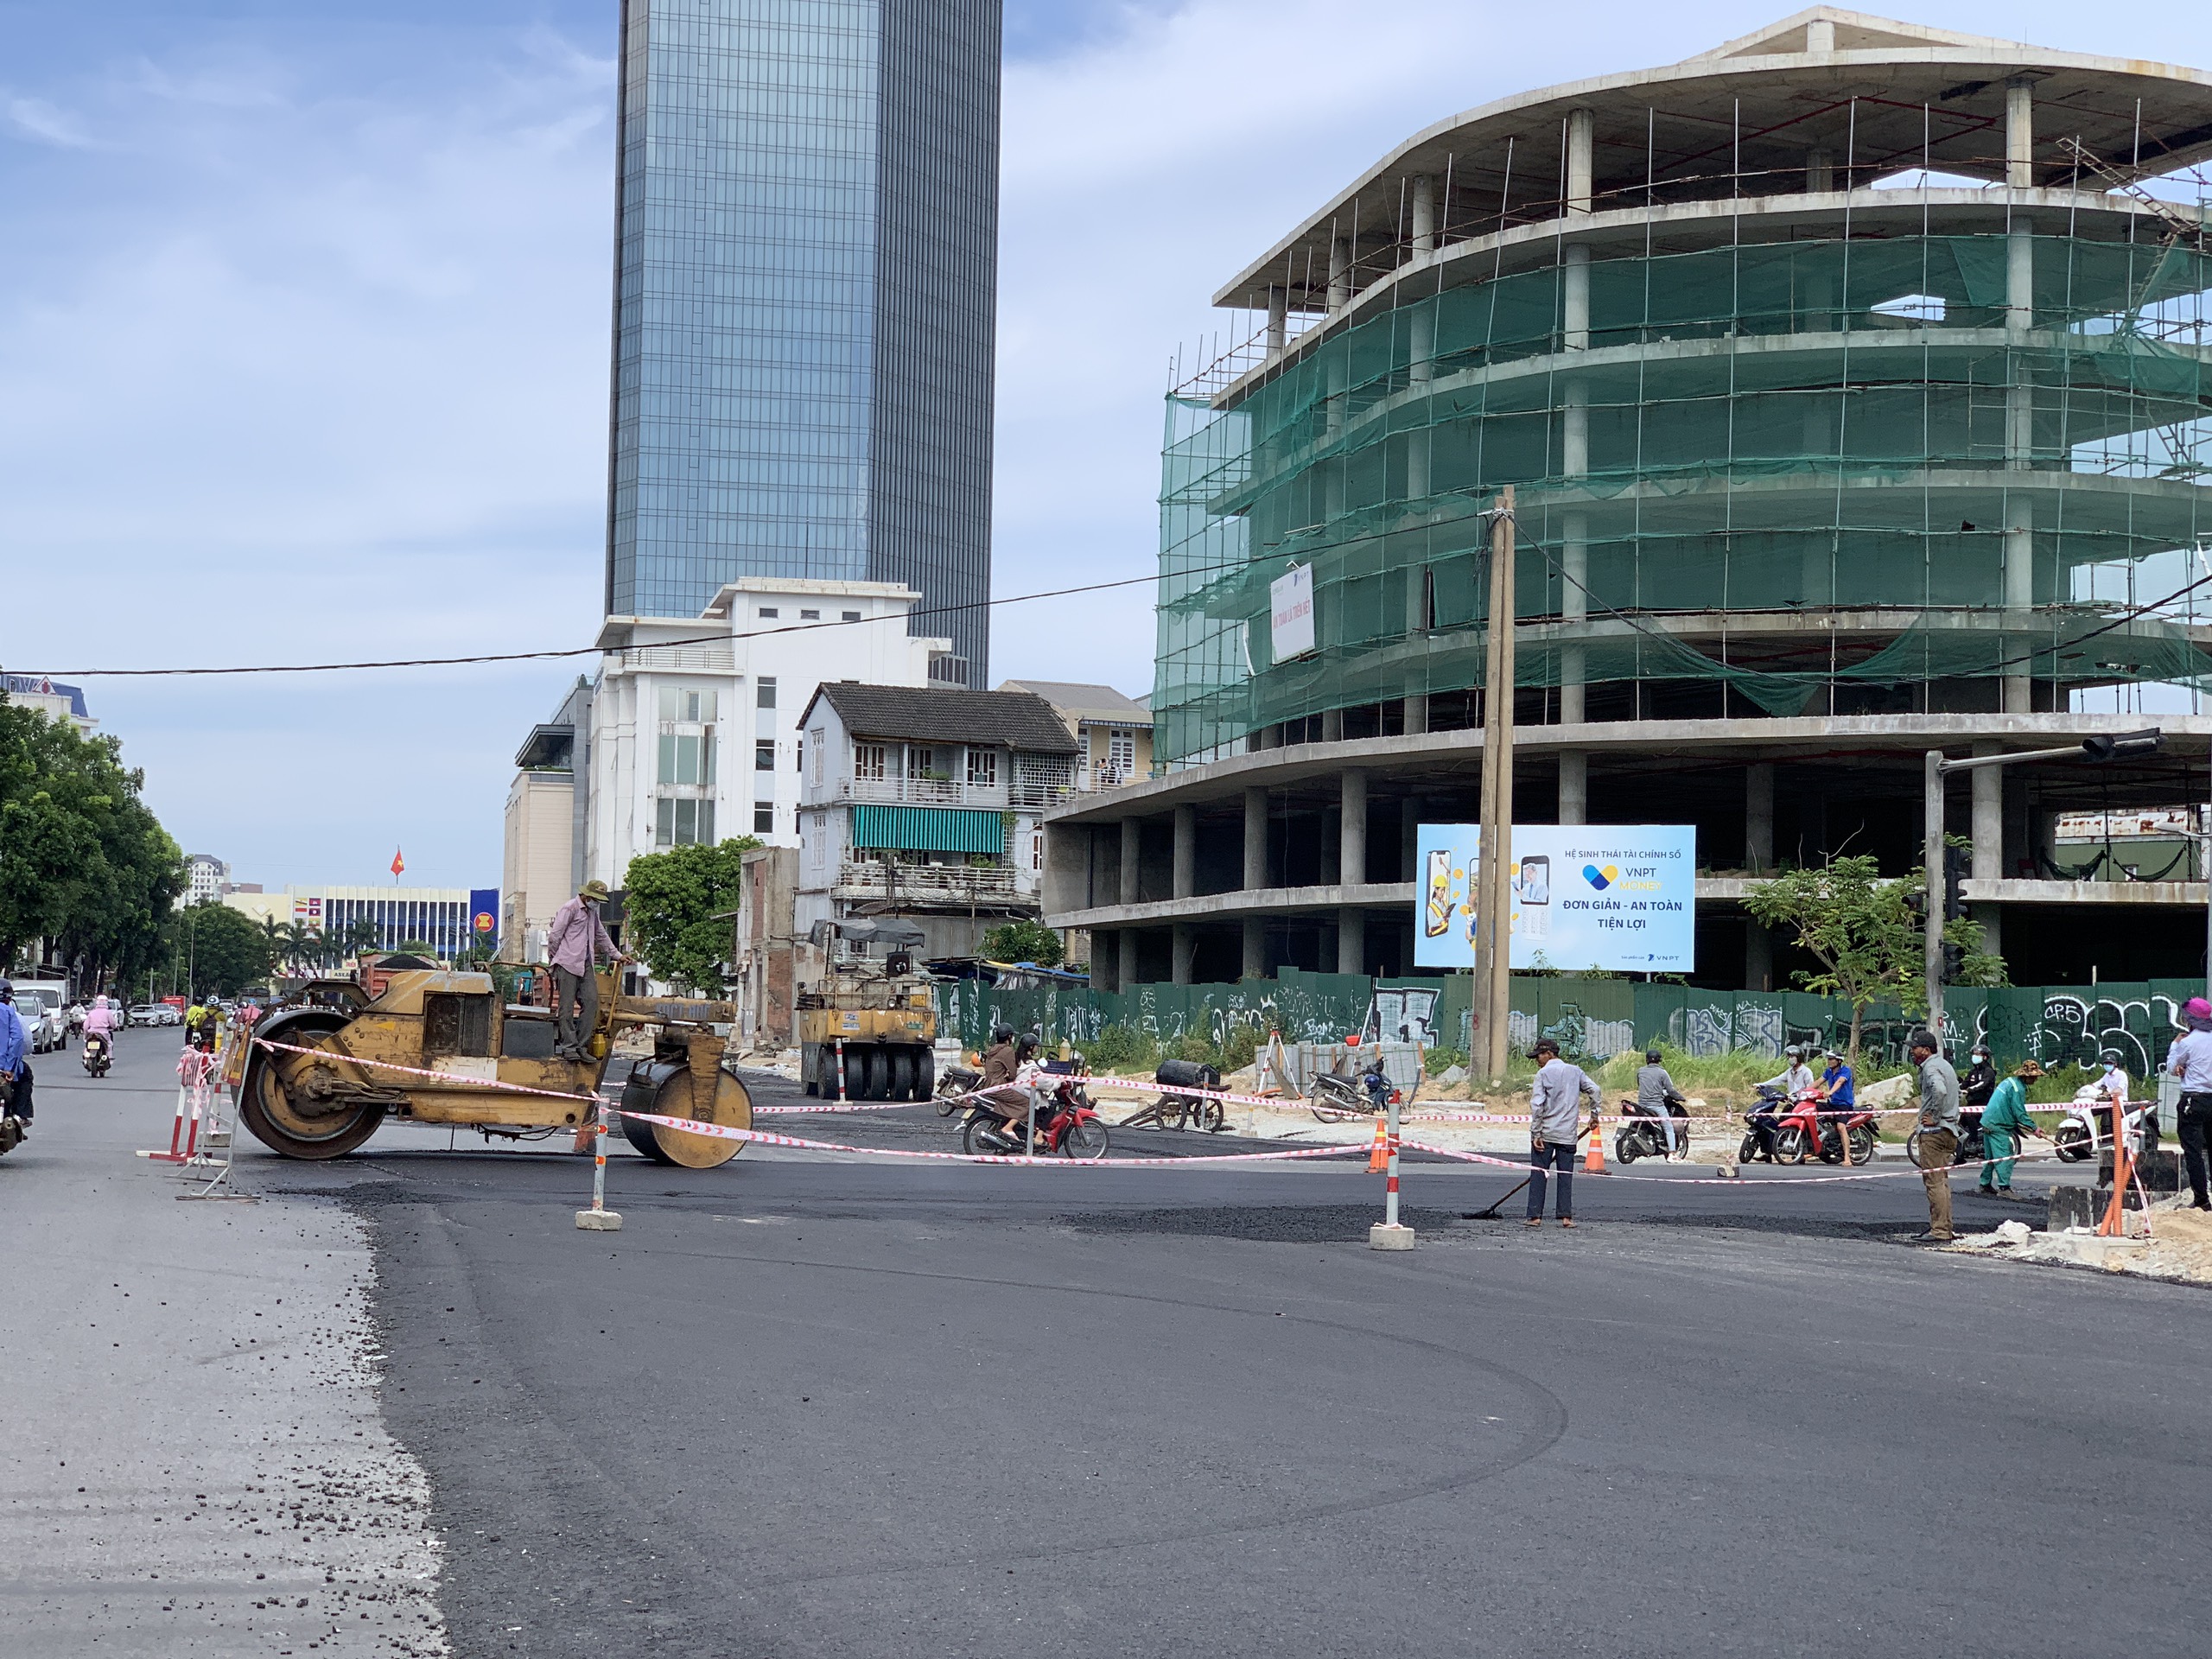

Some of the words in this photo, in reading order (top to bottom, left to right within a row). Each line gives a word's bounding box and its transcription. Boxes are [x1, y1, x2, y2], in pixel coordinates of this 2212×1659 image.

[1565, 849, 1576, 860] HỆ
[1601, 849, 1621, 858] THÁI
[1624, 849, 1637, 858] TÀI
[1639, 849, 1667, 859] CHÍNH
[1669, 849, 1681, 859] SỐ
[1625, 868, 1656, 877] VNPT
[1619, 880, 1662, 890] MONEY
[1563, 899, 1589, 910] ĐƠN
[1592, 897, 1620, 910] GIẢN
[1630, 901, 1647, 911] AN
[1649, 899, 1682, 911] TOÀN
[1598, 916, 1624, 931] TIỆN
[1627, 919, 1646, 931] LỢI
